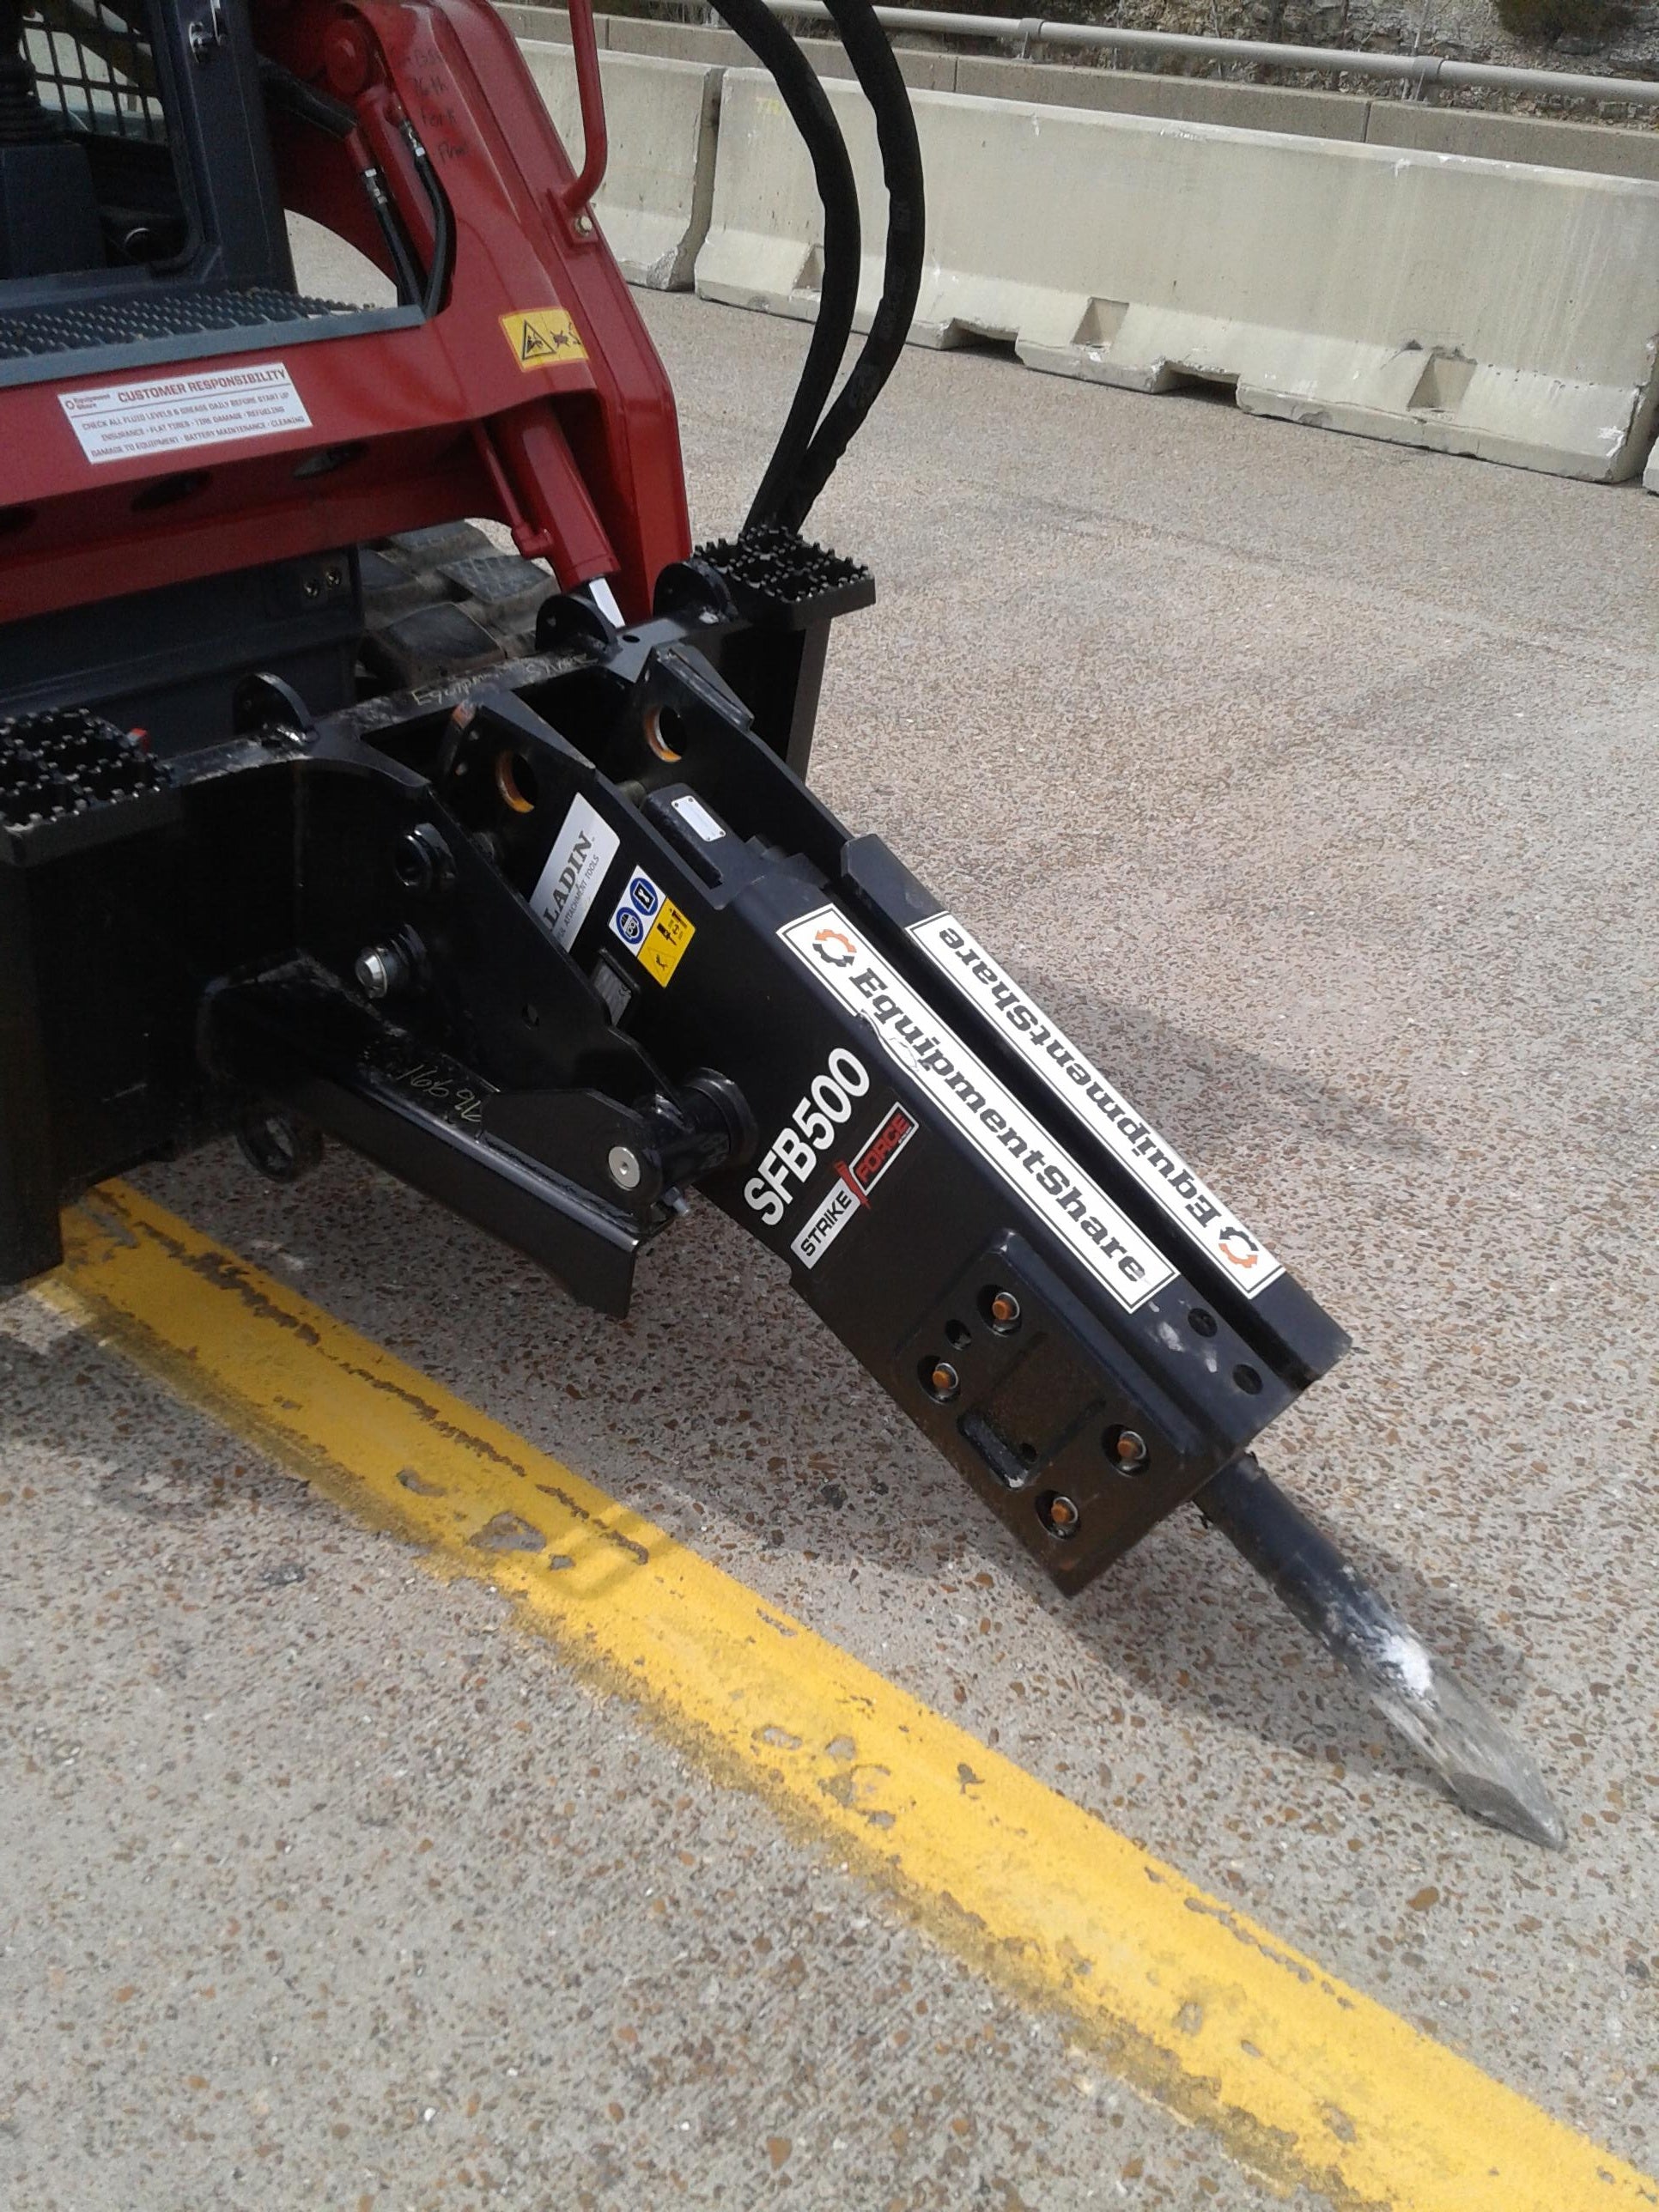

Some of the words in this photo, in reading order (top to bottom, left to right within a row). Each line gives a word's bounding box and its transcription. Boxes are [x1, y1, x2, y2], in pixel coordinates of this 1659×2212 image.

[82, 419, 108, 430] CHECK
[109, 417, 122, 426] ALL
[124, 415, 145, 423] FLUID
[146, 410, 174, 421] LEVELS
[179, 404, 208, 415] GREASE
[209, 400, 230, 410] DAILY
[230, 397, 257, 407] BEFORE
[258, 393, 279, 403] START
[118, 383, 186, 402] CUSTOMER
[188, 369, 286, 392] RESPONSIBILITY
[150, 424, 167, 434] FLAT
[212, 413, 242, 423] DAMAGE
[246, 406, 285, 417] REFUELING
[91, 447, 123, 457] DAMAGE
[124, 443, 135, 452] TO
[137, 436, 179, 450] EQUIPMENT
[184, 431, 215, 441] BATTERY
[216, 422, 265, 436] MAINTENANCE
[271, 416, 305, 428] CLEANING
[543, 830, 592, 932] LADIN
[563, 879, 587, 925] ATTACHMENT
[585, 854, 599, 880] TOOLS
[939, 927, 1222, 1231] EquipmentShare
[744, 1048, 870, 1226] SFB500
[848, 967, 1149, 1284] EquipmentShare
[800, 1190, 852, 1257] STRIKE
[854, 1112, 912, 1183] FORCE
